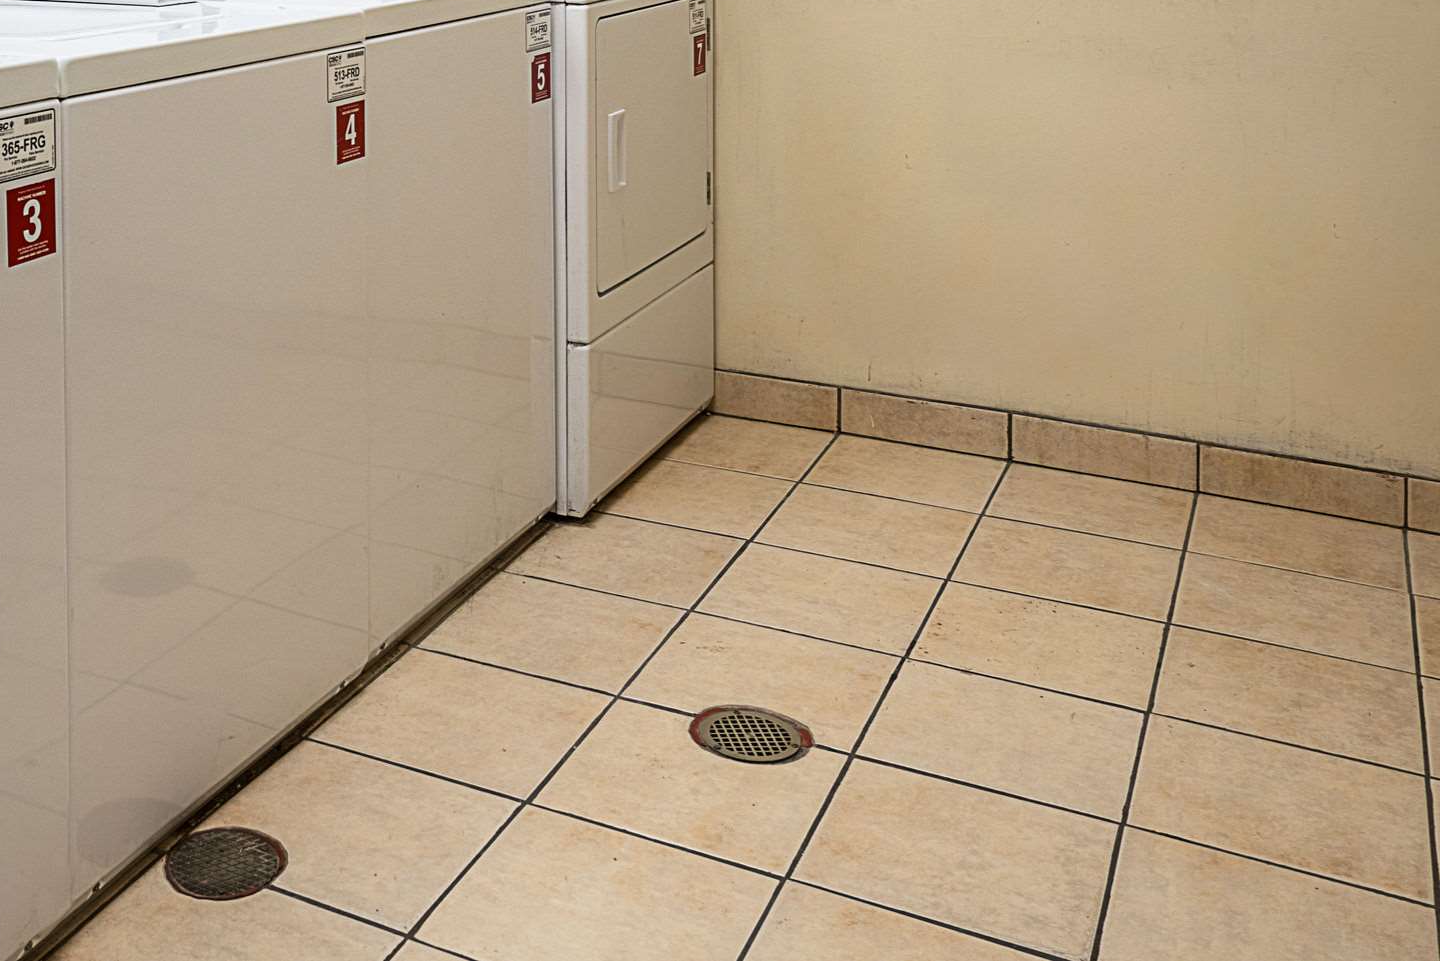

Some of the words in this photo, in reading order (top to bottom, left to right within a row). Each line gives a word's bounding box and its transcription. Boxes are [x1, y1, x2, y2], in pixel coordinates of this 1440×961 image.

[697, 43, 703, 65] 7
[537, 63, 545, 91] 5
[344, 113, 357, 146] 4
[1, 134, 46, 157] 365-FRG
[23, 198, 42, 243] 3
